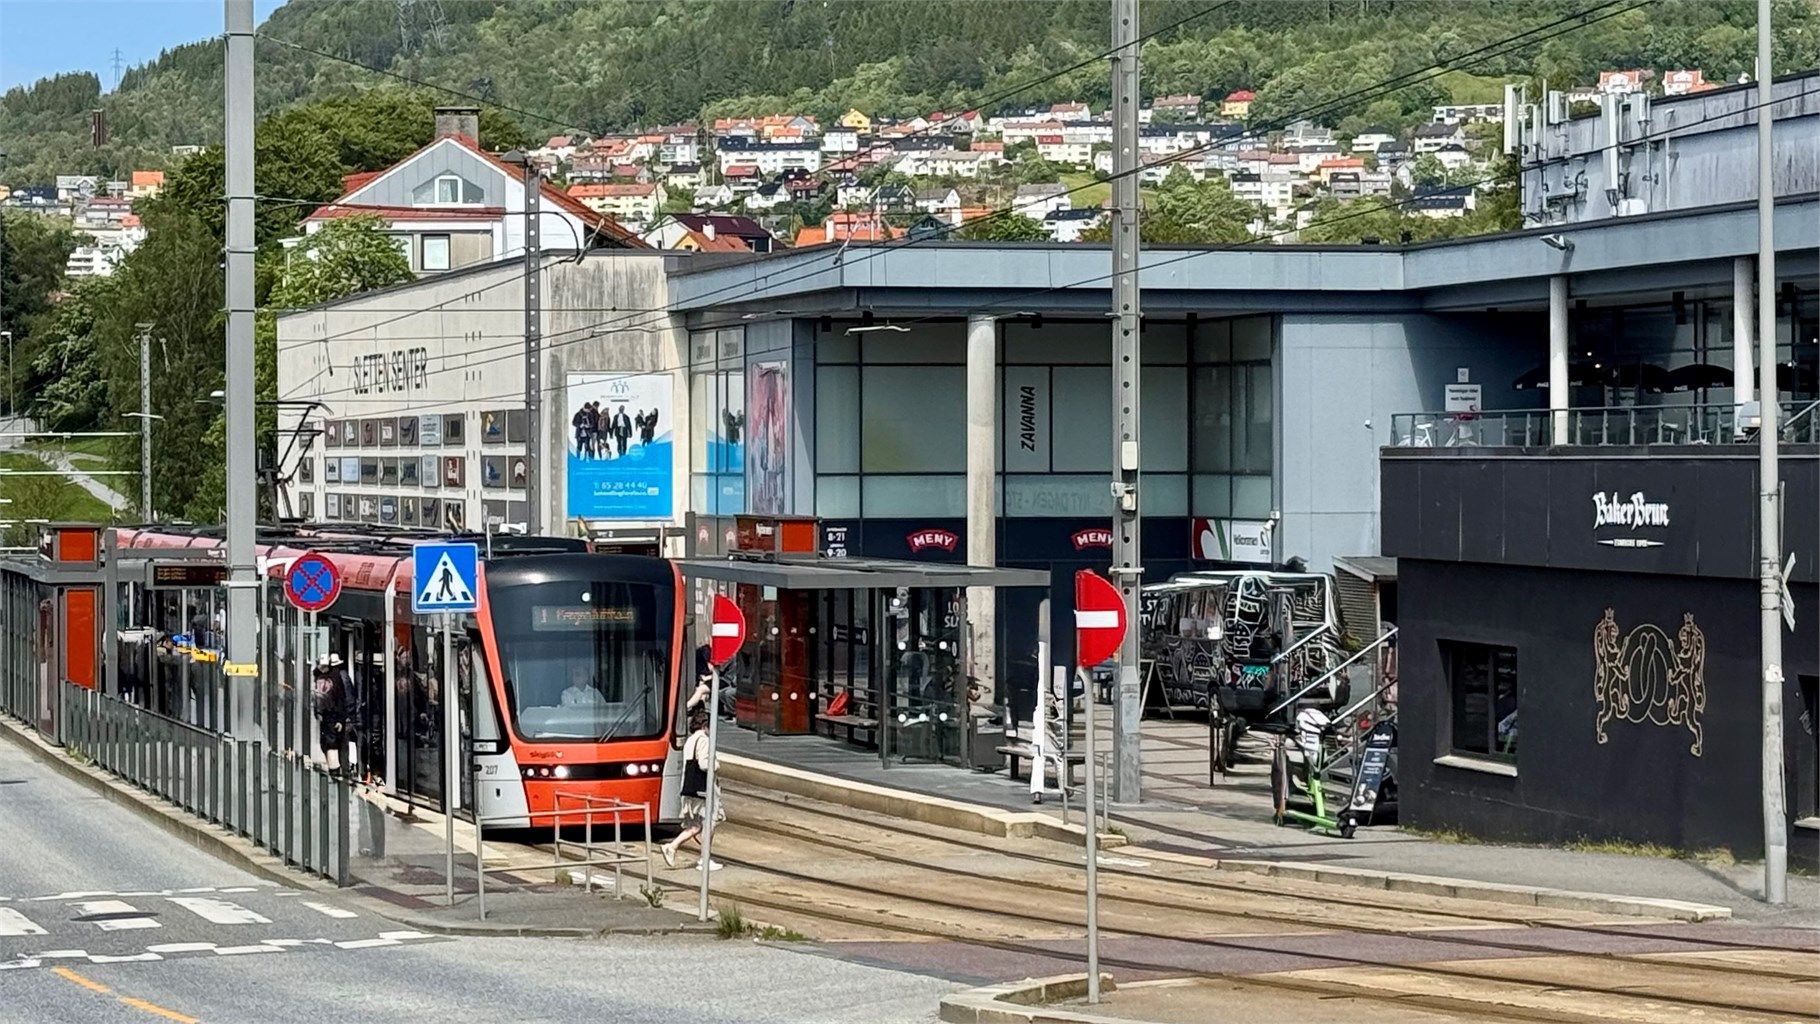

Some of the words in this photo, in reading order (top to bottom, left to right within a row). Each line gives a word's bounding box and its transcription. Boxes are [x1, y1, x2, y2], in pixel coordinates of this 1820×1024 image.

[354, 352, 390, 395] SLETTEN
[391, 346, 428, 392] SENTER
[1020, 386, 1035, 452] ZAVANNA
[601, 481, 612, 490] 65
[613, 481, 624, 490] 28
[625, 481, 636, 490] 44
[637, 481, 648, 490] 40
[913, 532, 953, 547] MENY
[1077, 532, 1114, 546] MENY
[485, 765, 499, 776] 207
